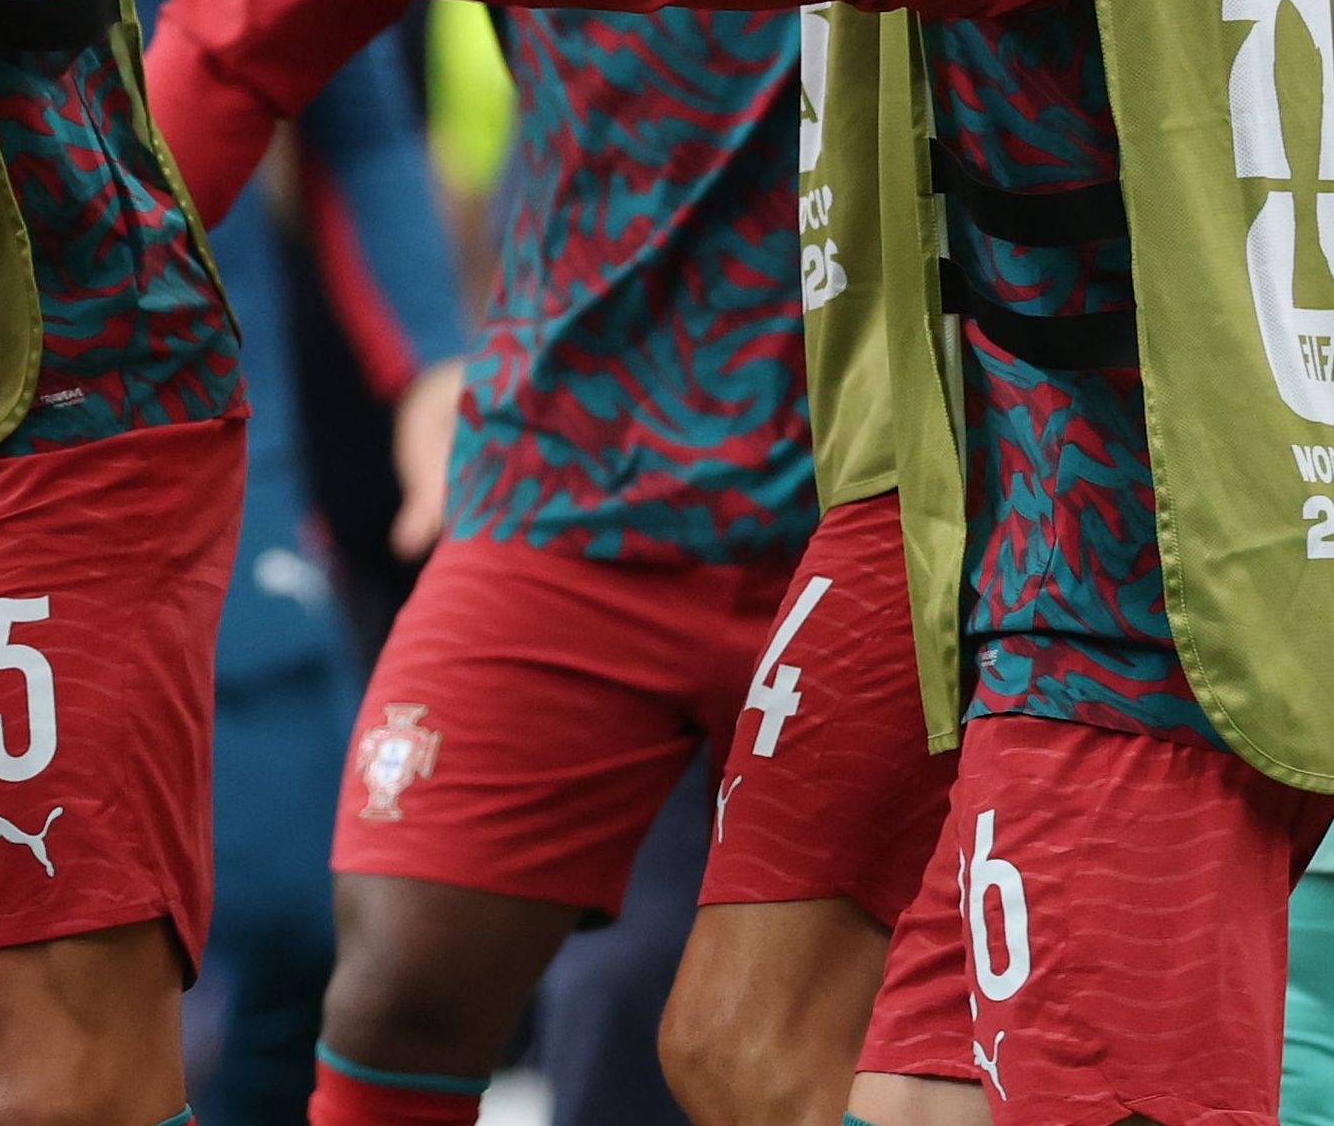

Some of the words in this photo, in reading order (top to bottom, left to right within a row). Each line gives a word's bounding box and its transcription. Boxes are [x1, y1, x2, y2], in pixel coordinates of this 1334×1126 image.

[801, 238, 848, 314] 26
[1298, 334, 1334, 382] FIF
[744, 576, 833, 758] 4
[958, 809, 1031, 1021] 6
